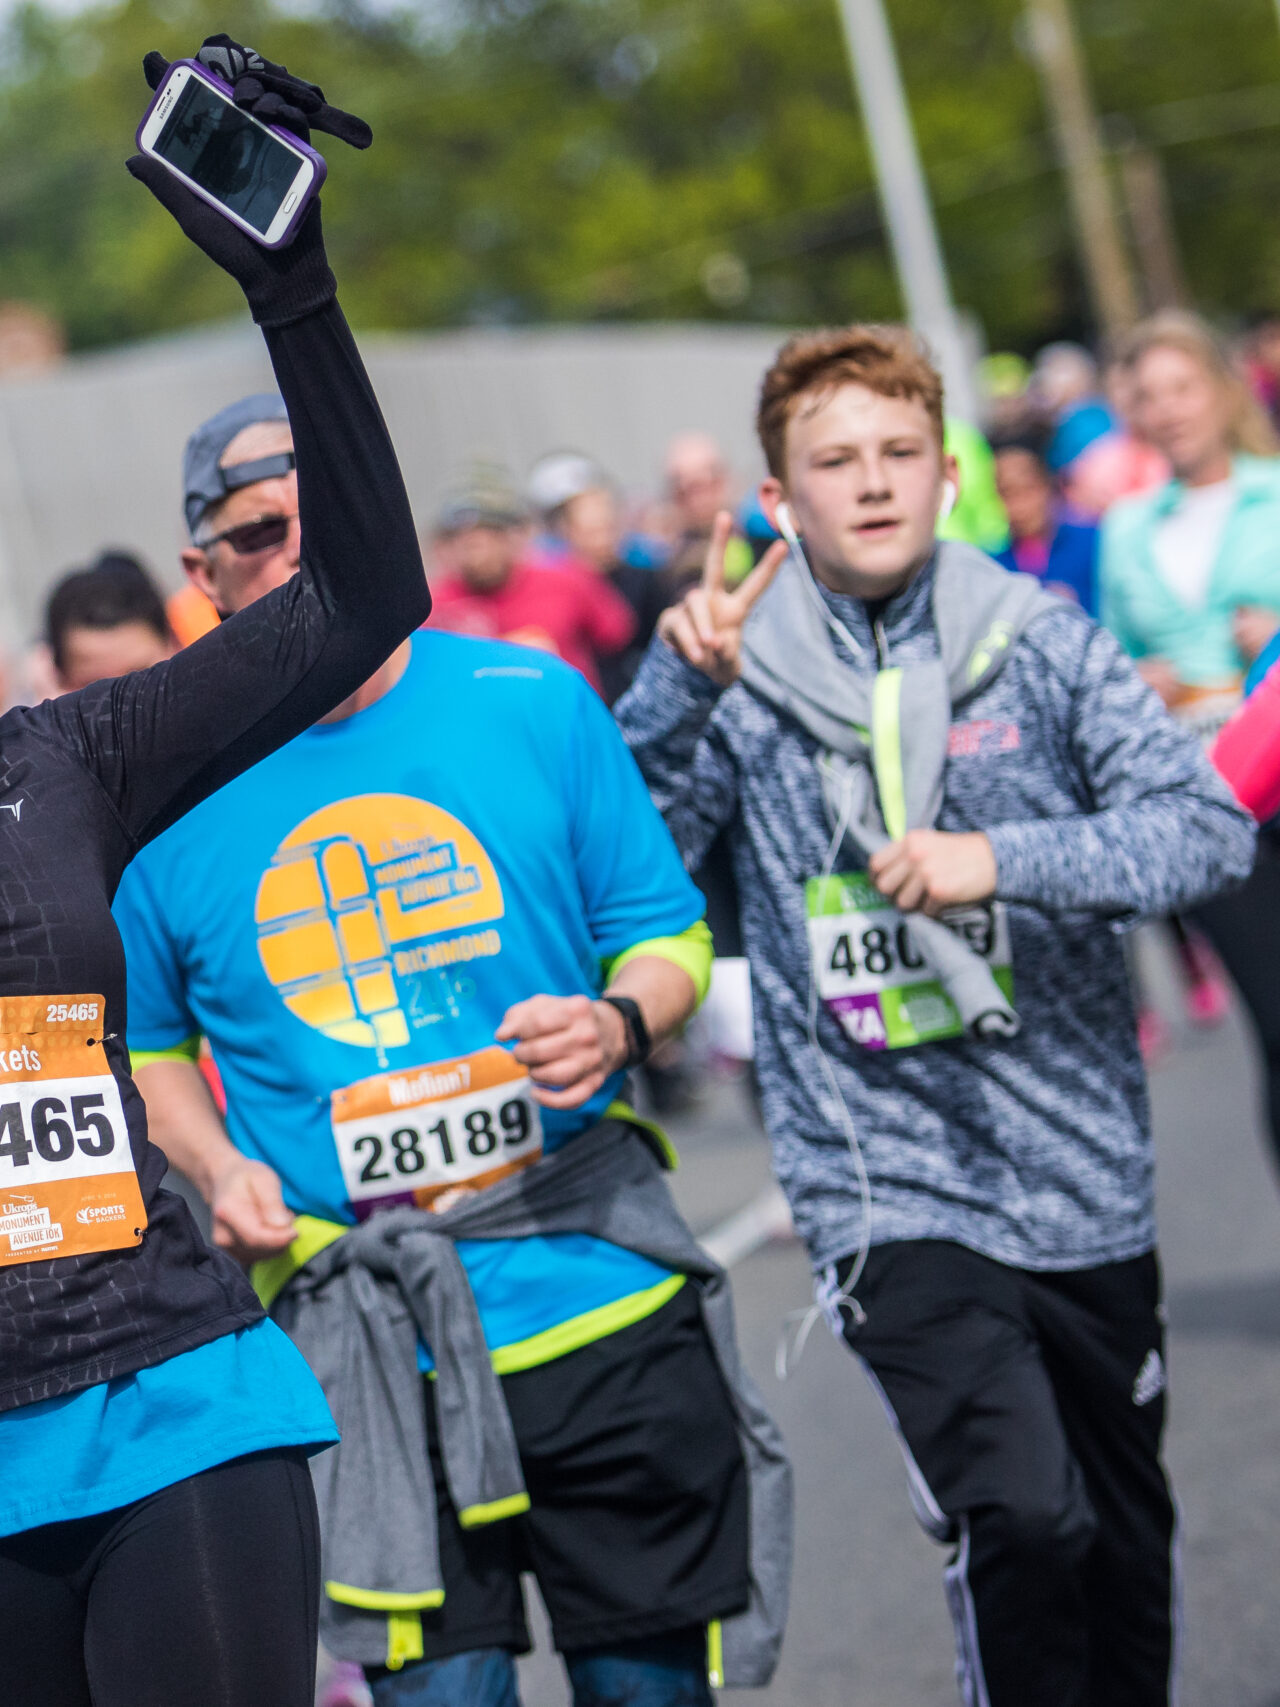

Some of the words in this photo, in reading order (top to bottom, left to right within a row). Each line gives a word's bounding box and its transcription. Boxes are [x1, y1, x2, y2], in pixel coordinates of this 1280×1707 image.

[393, 928, 502, 977] RICHMOND
[46, 1003, 99, 1023] 25465
[353, 1099, 530, 1183] 28189
[89, 1204, 125, 1218] SPORTS
[96, 1213, 127, 1223] BACKERS
[13, 1229, 45, 1245] AVENUE
[45, 1227, 61, 1240] 10K
